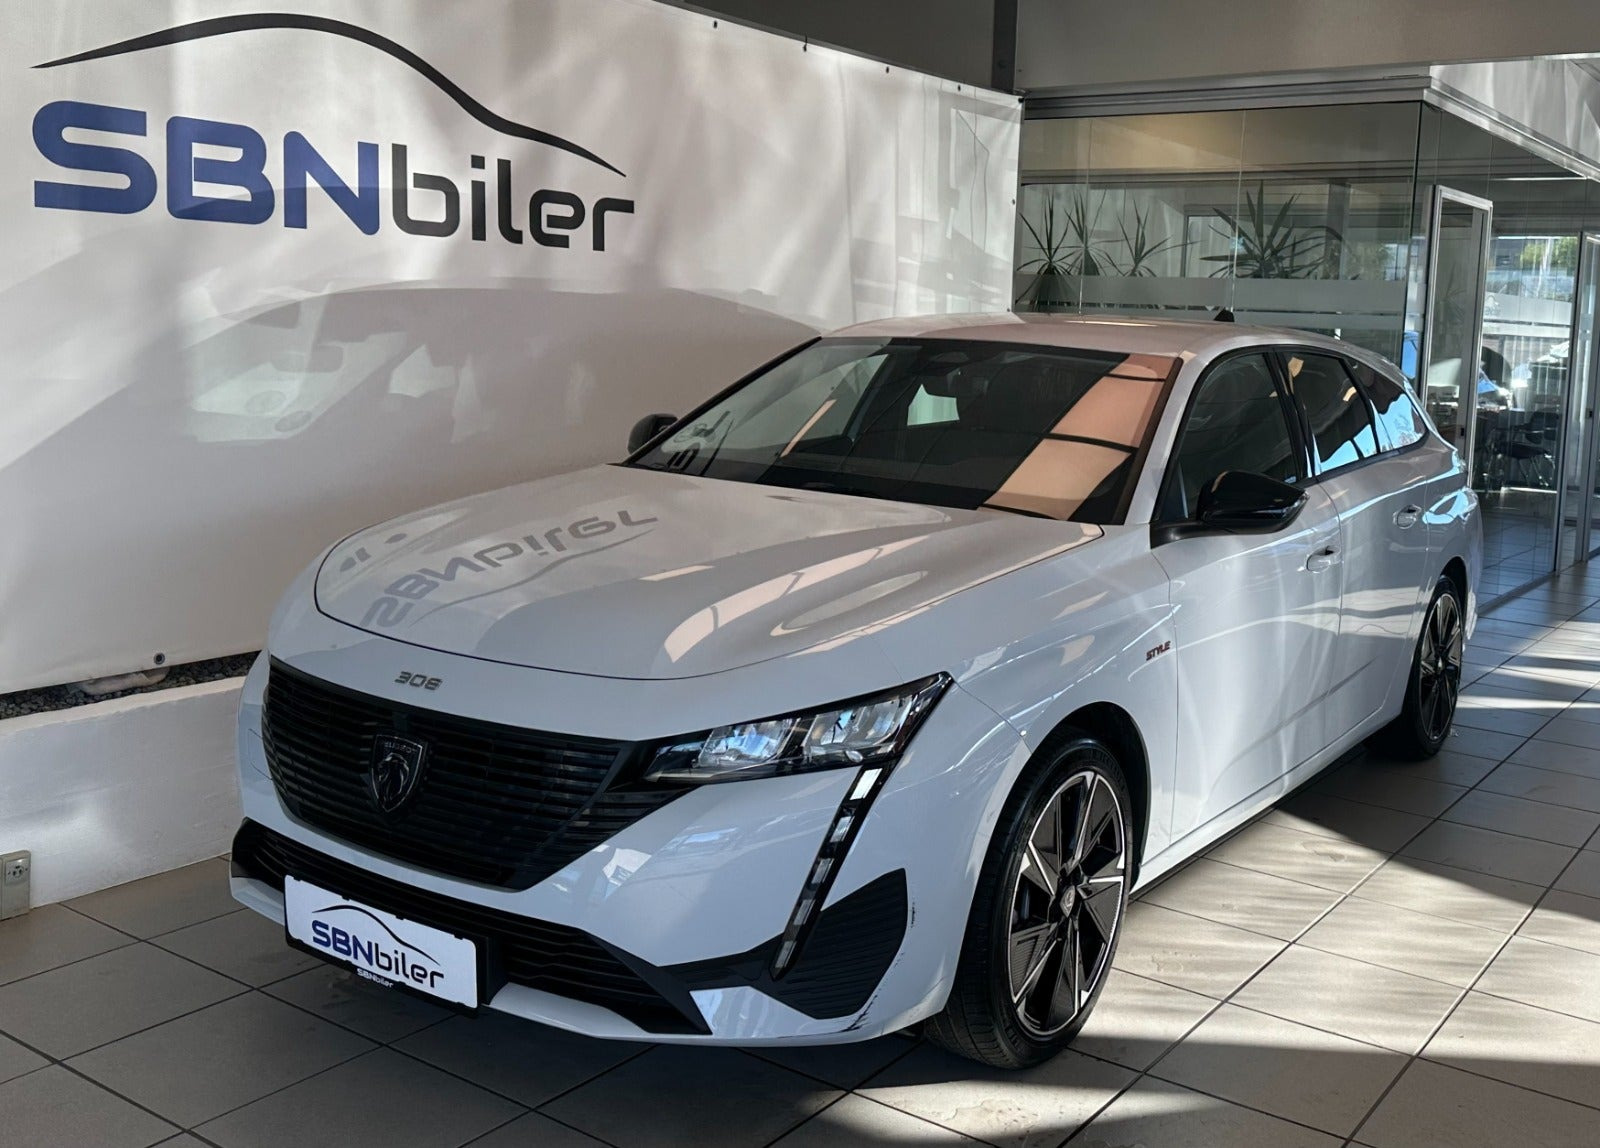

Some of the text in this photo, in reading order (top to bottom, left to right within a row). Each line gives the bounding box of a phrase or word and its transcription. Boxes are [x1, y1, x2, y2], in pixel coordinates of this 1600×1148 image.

[32, 100, 634, 252] SBNbiler
[1145, 640, 1171, 661] STYLE
[394, 671, 443, 691] 308
[312, 920, 444, 988] SBNbiler
[357, 968, 394, 988] SBNbiler
